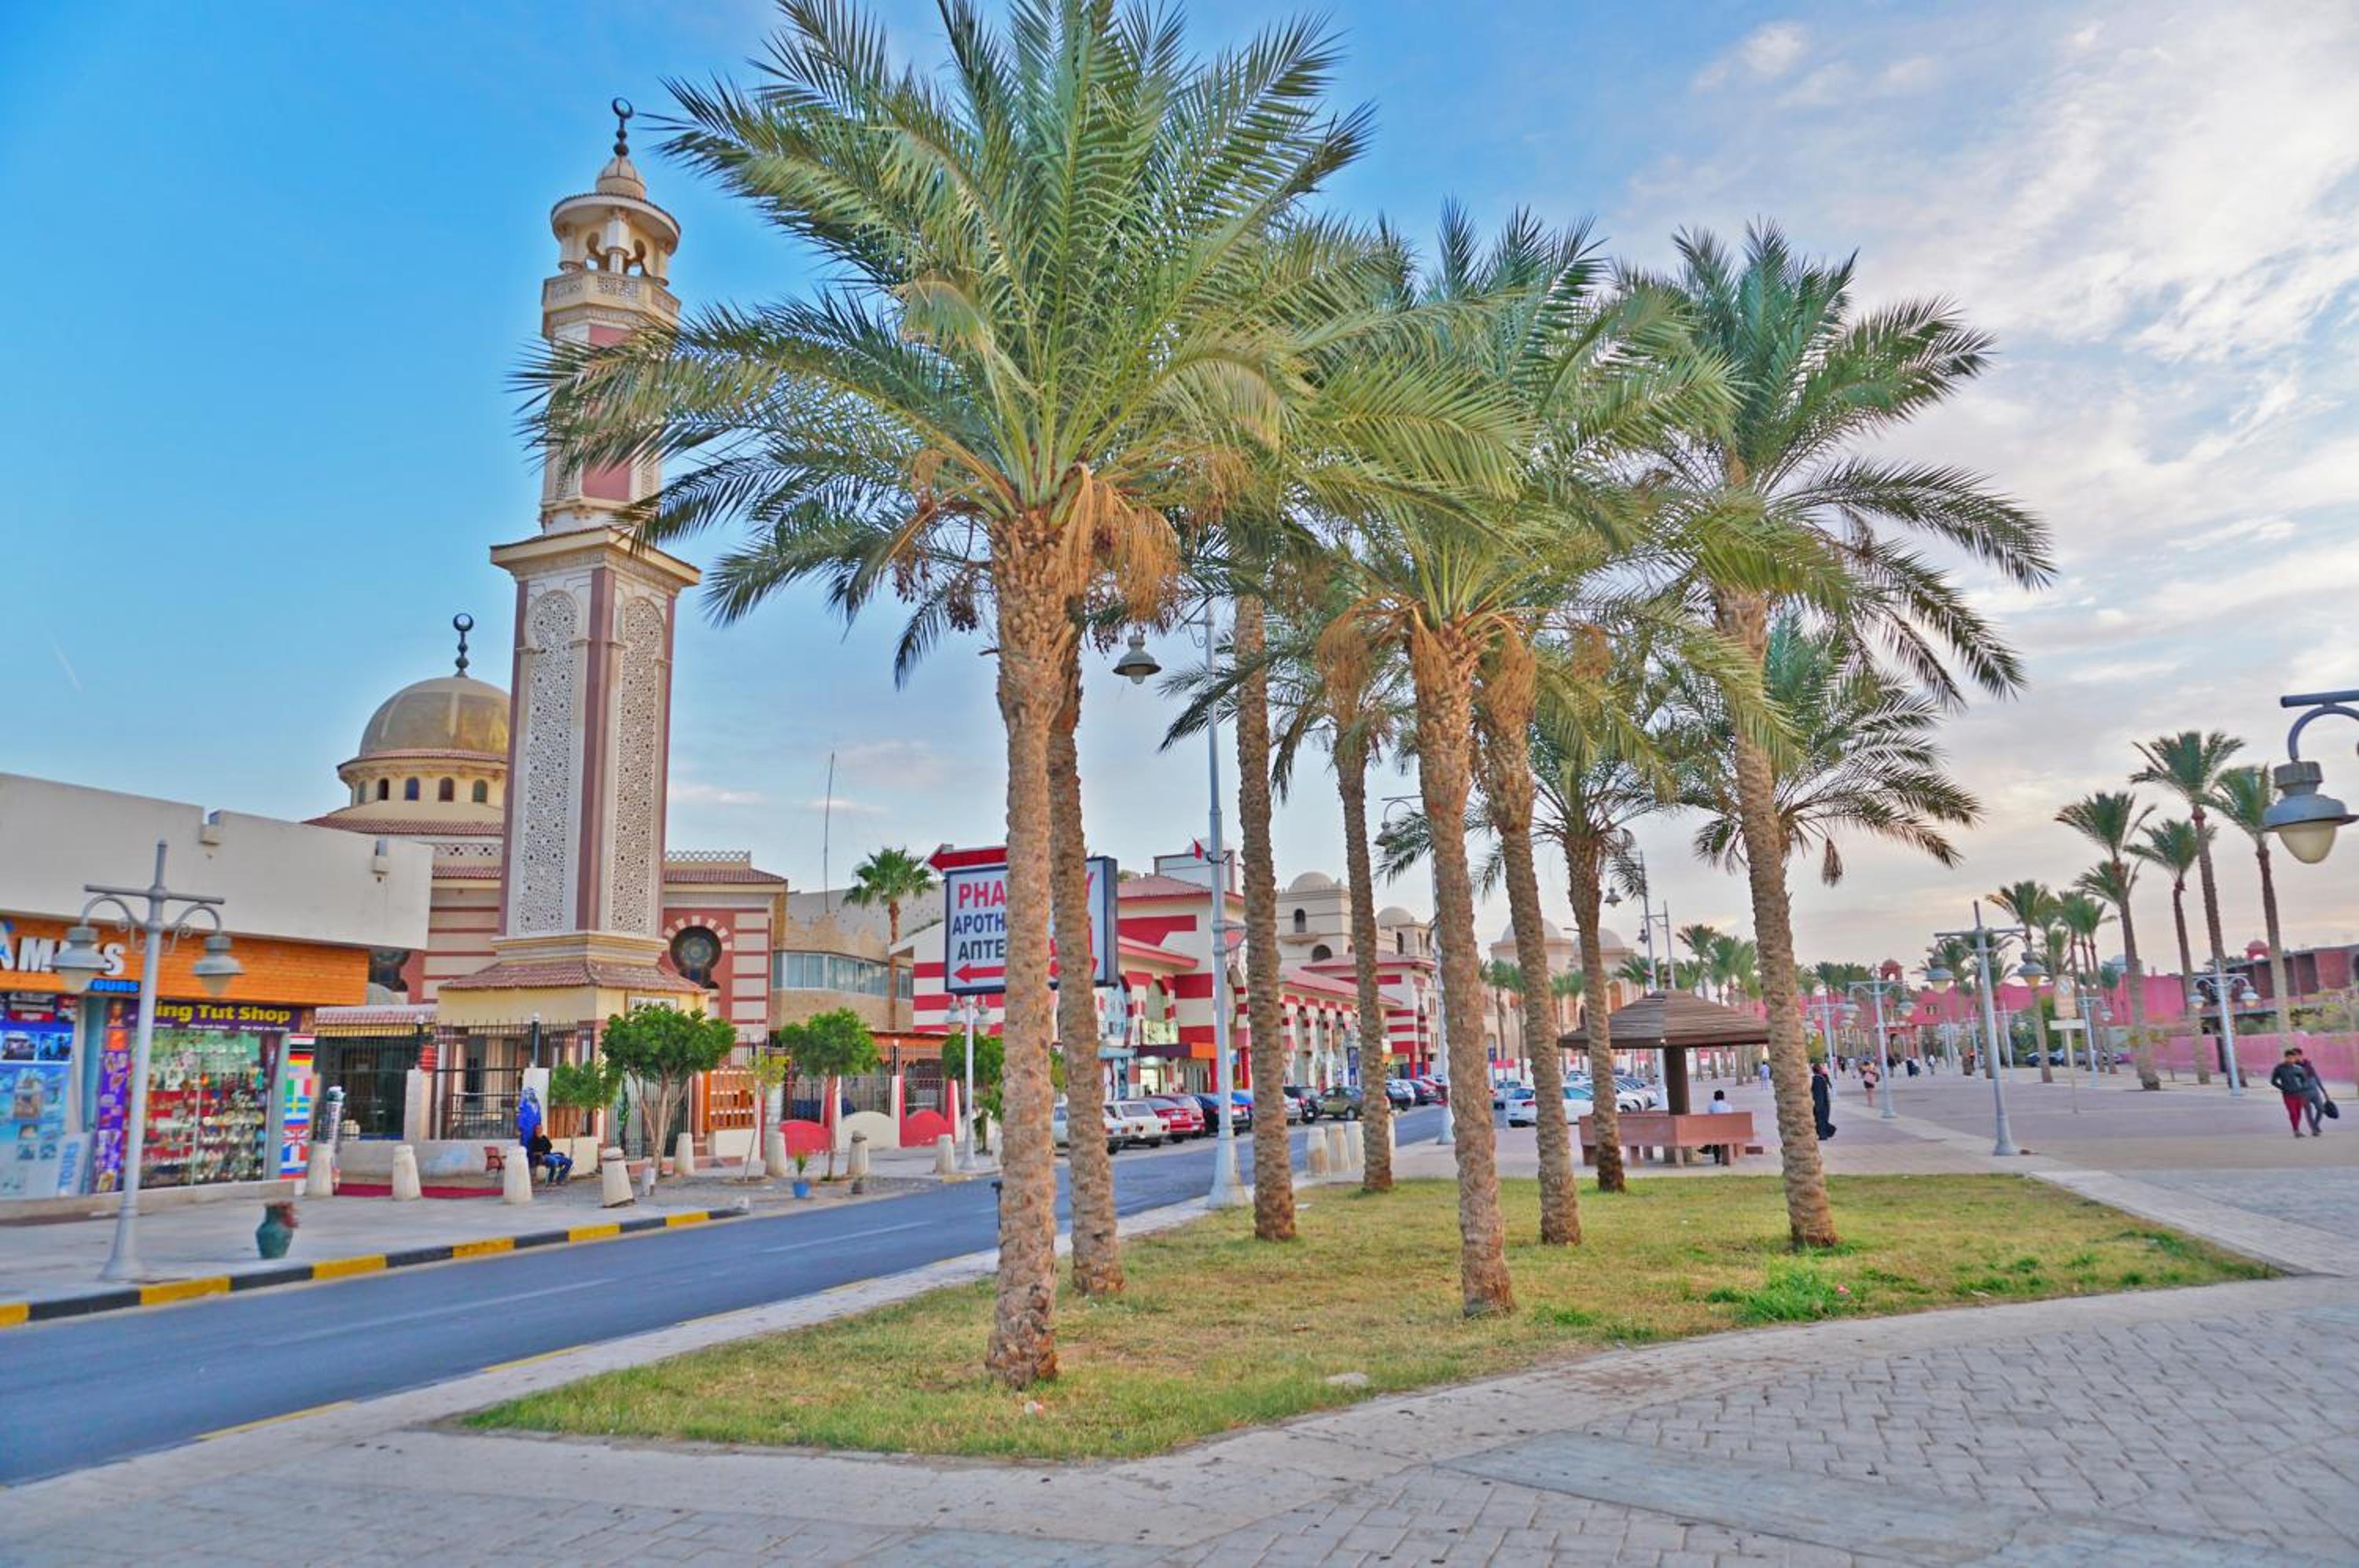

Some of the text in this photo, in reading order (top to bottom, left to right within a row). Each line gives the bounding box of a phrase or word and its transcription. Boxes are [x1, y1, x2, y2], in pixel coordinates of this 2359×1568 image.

[958, 880, 1007, 909] PHA
[952, 911, 1007, 936] APOTH
[957, 938, 1006, 960] АПТЕ
[156, 1001, 290, 1023] ing Tut Shop
